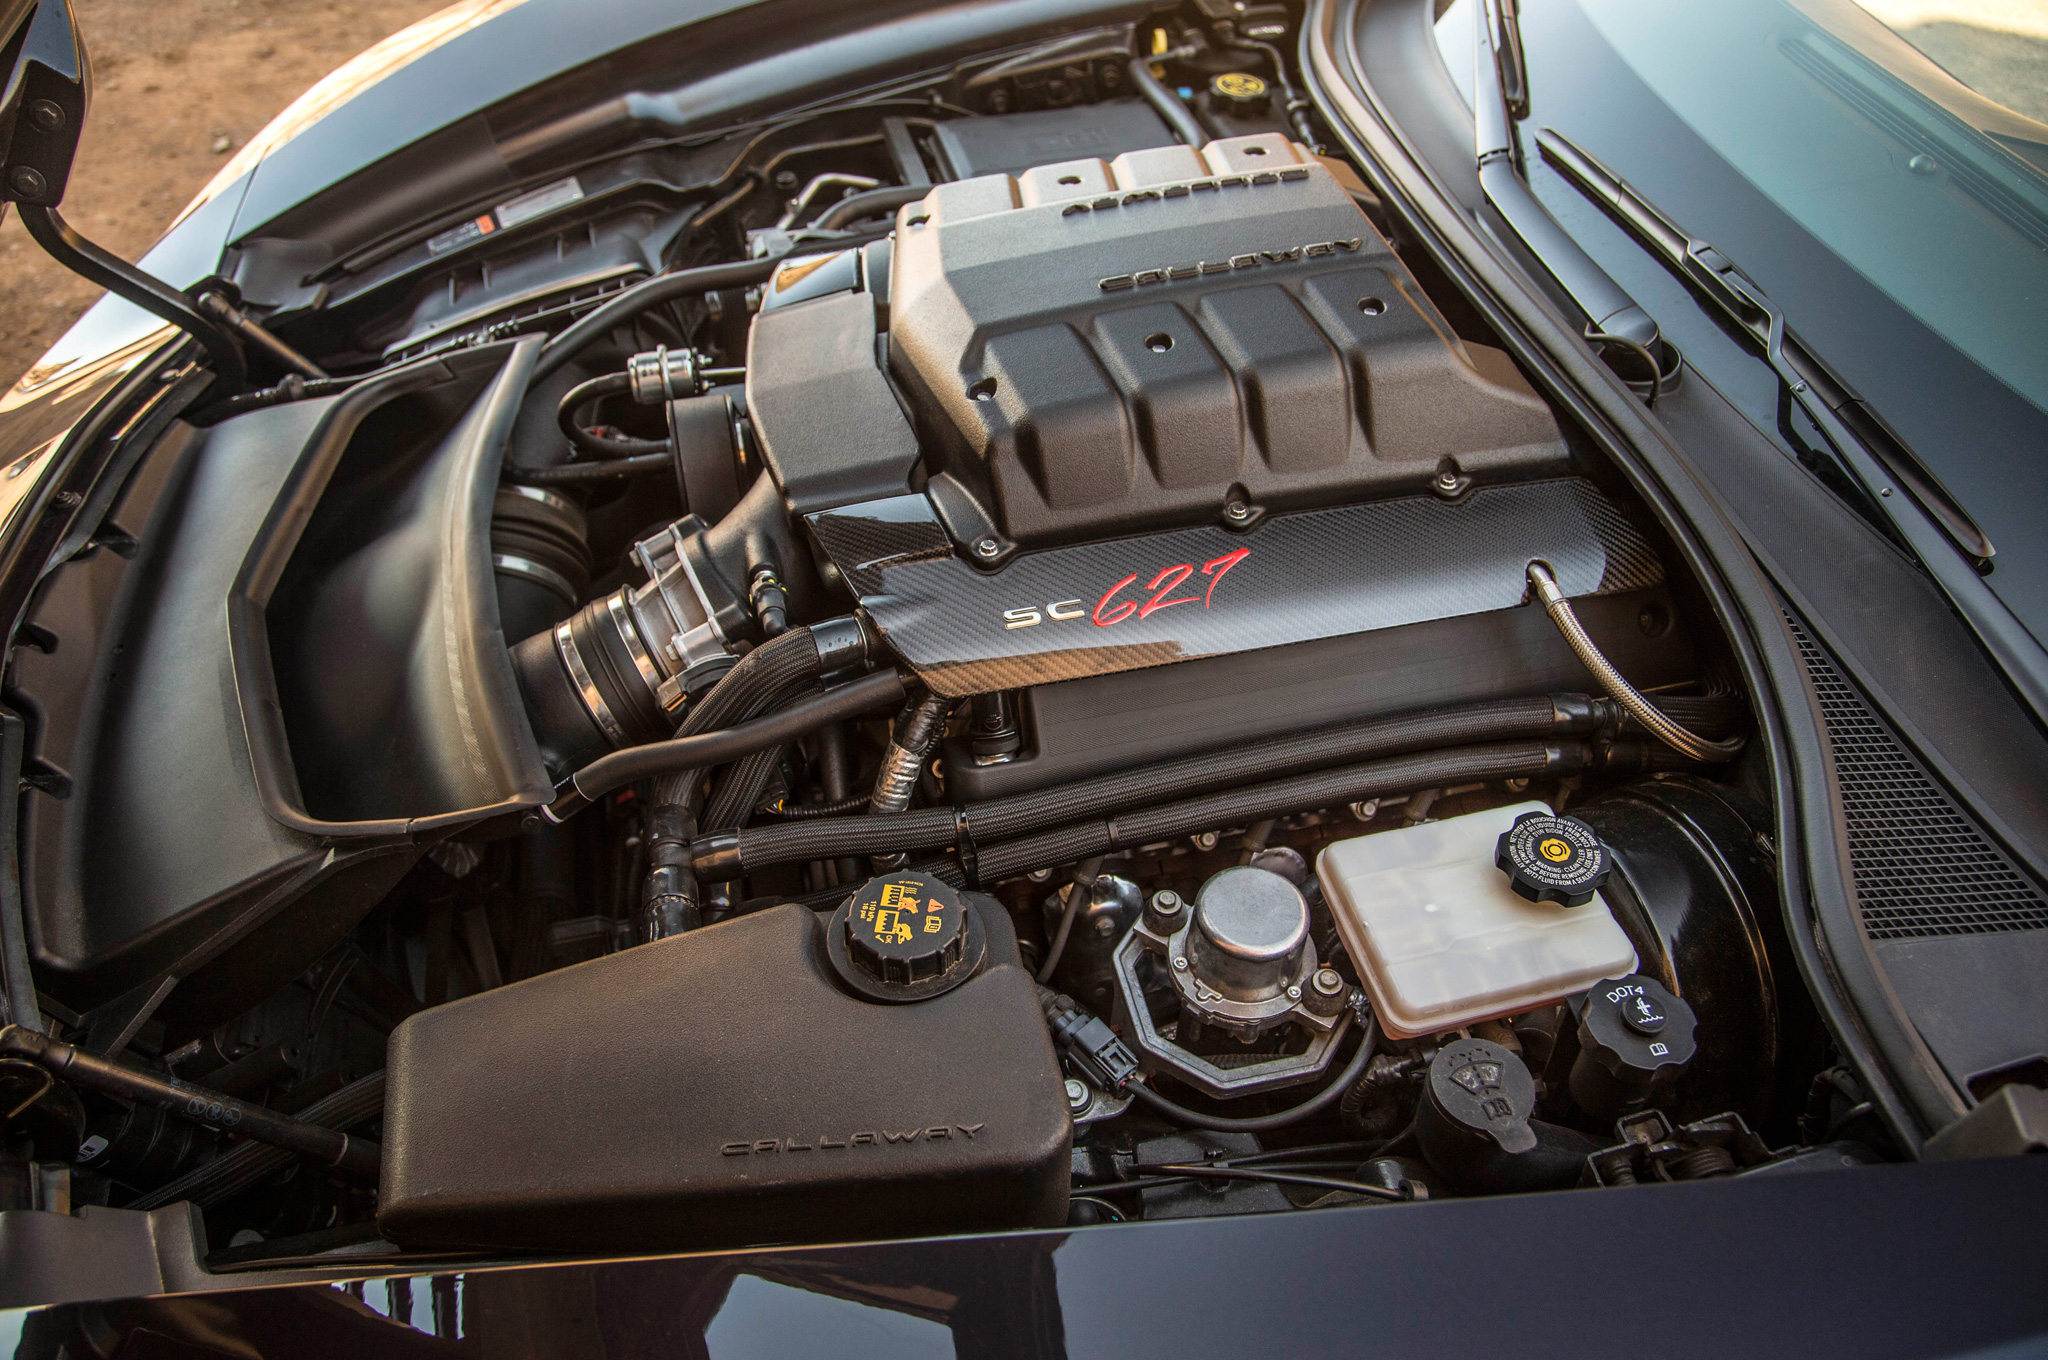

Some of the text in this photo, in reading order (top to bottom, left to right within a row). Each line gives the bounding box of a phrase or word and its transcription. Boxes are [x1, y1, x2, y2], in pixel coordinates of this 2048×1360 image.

[1098, 237, 1363, 291] CALLAWAY
[1003, 547, 1251, 630] SC 627
[1557, 818, 1575, 828] AVANT
[1574, 825, 1584, 833] LA
[1564, 826, 1582, 838] FREIN
[1528, 863, 1541, 873] CAP
[1538, 869, 1561, 879] BEFORE
[1563, 862, 1581, 873] CLEAN
[1537, 875, 1555, 885] FLUID
[867, 911, 875, 922] kPa
[885, 935, 893, 944] OK
[1606, 985, 1645, 1003] DOT4
[720, 1123, 985, 1156] CALLAWAY
